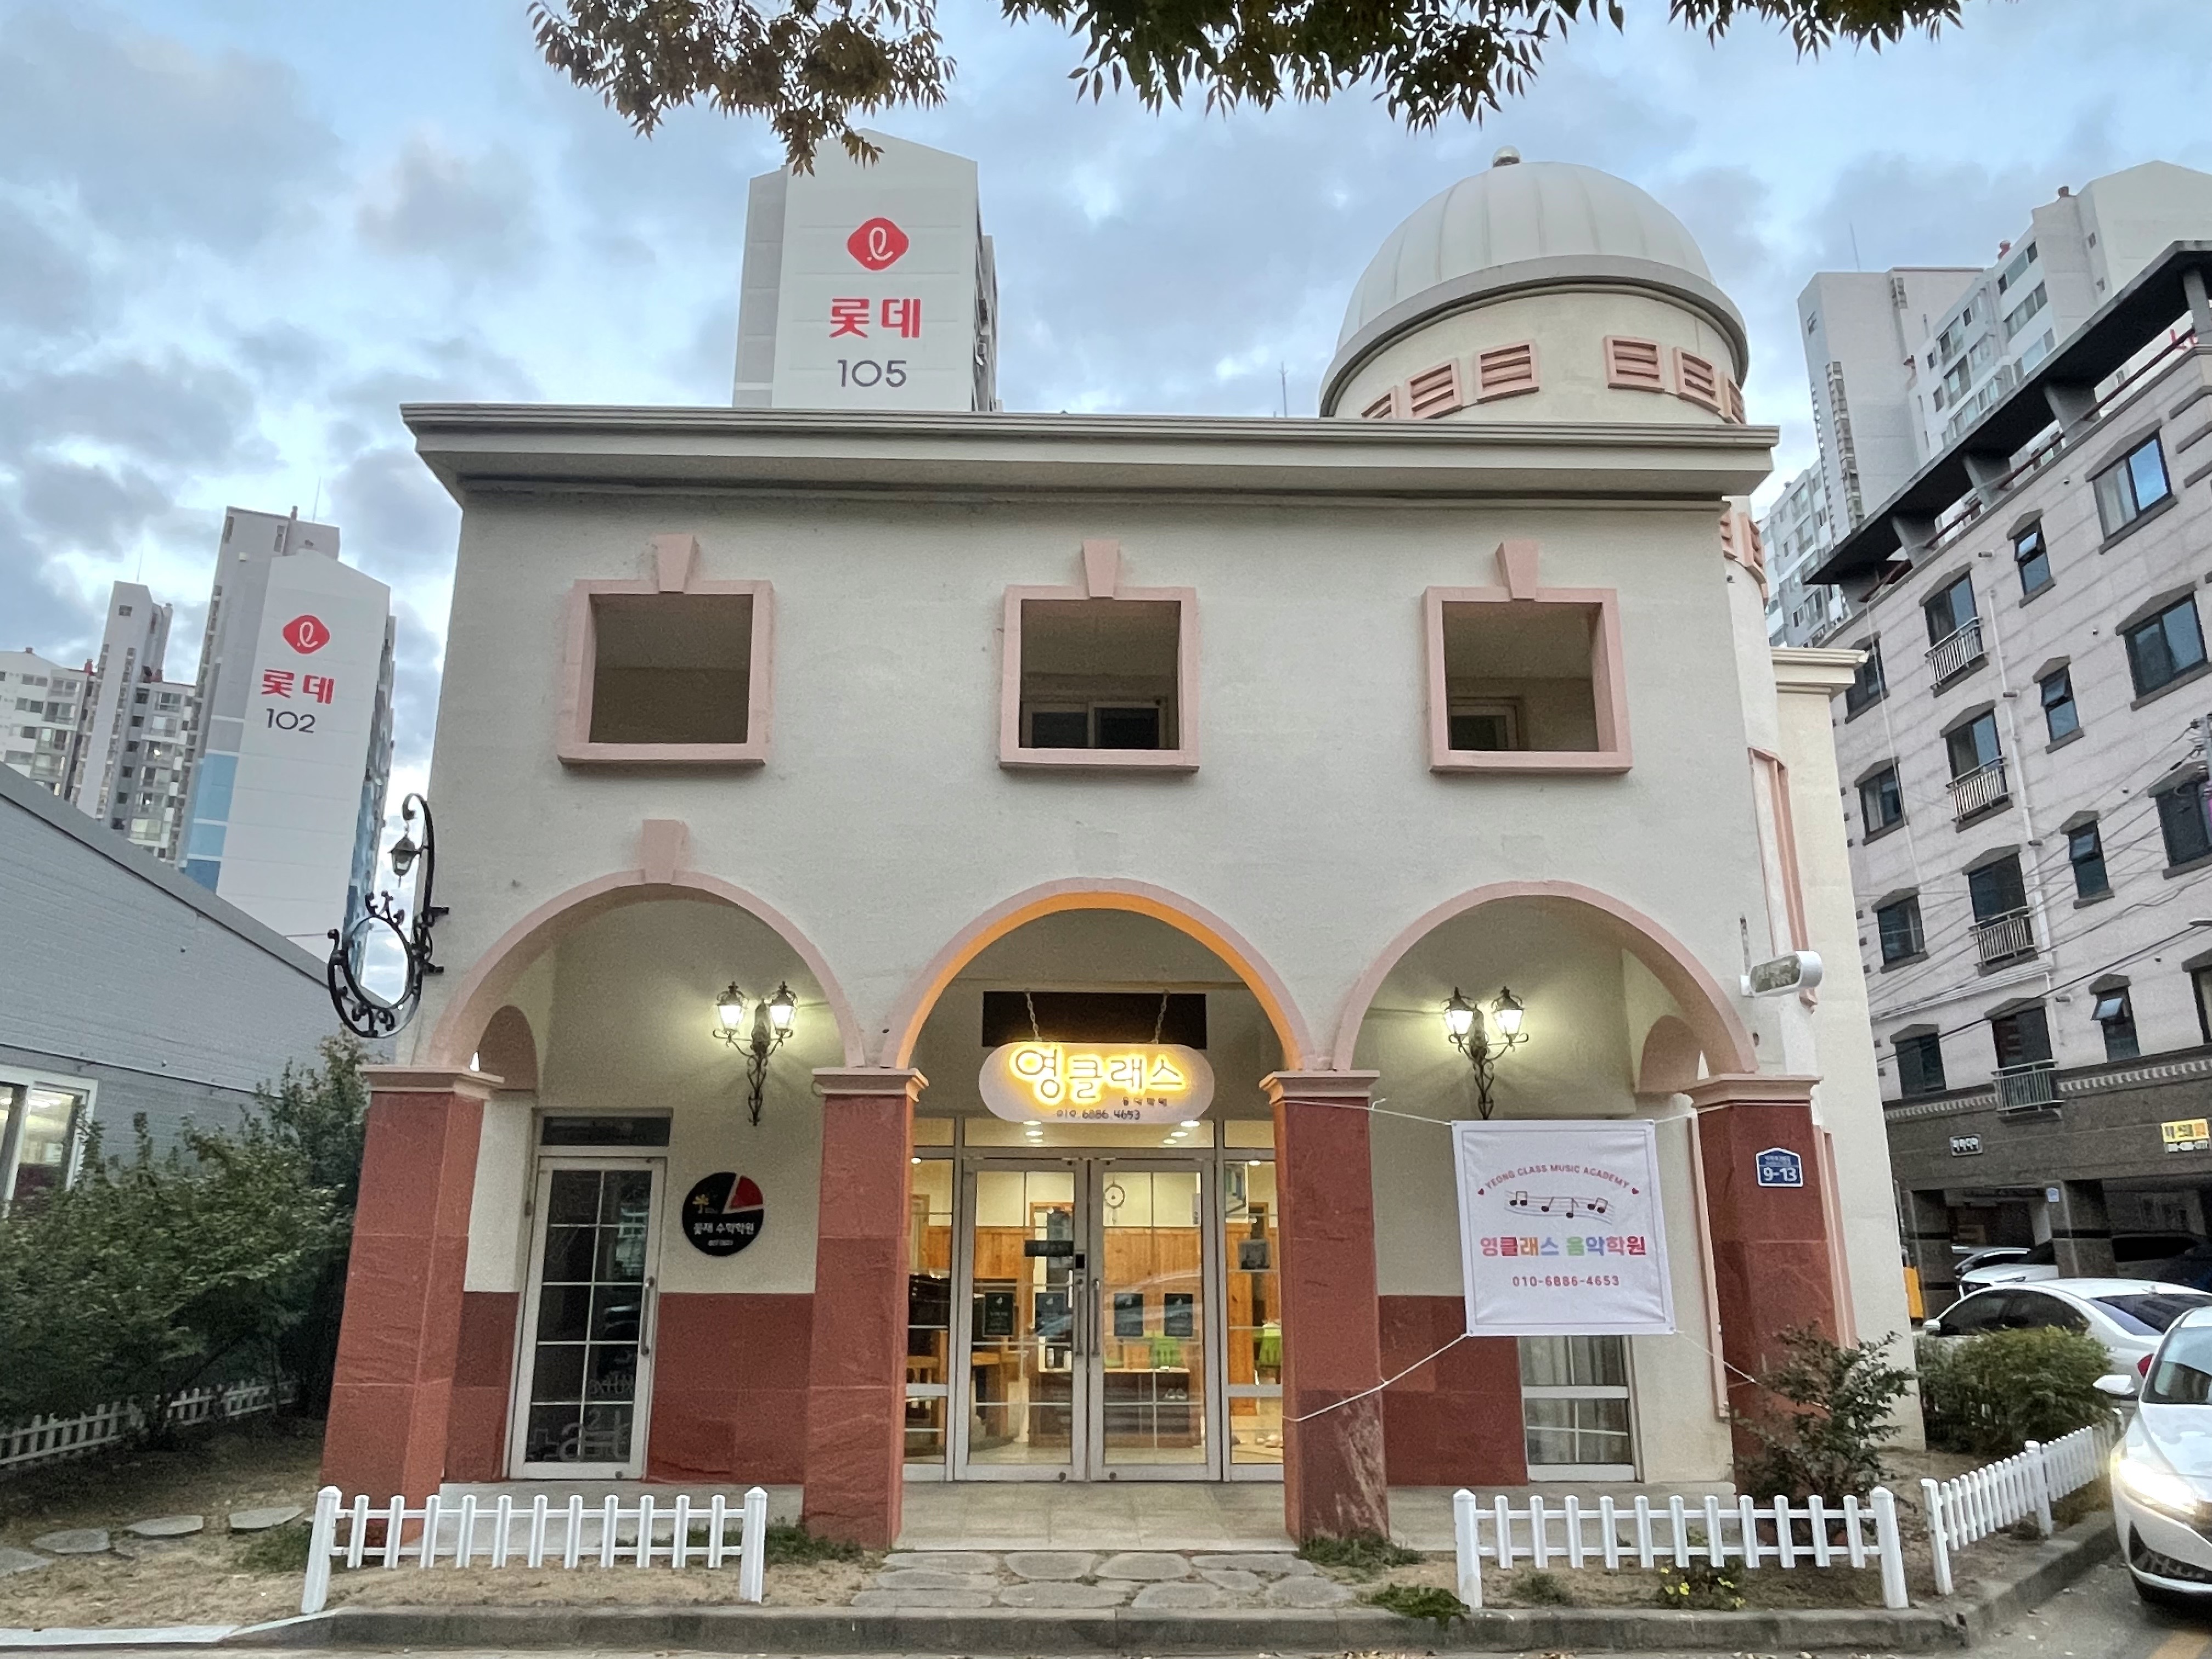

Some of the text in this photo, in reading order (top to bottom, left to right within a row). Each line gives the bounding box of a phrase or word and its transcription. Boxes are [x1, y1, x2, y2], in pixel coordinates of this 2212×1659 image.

[830, 298, 921, 338] 롯데
[837, 359, 907, 387] 105
[261, 668, 335, 704] 롯데
[266, 708, 316, 733] 102
[1013, 1047, 1184, 1101] 영클래스
[1485, 1164, 1630, 1190] YEONG CLASS MUSIC ACADEMY
[1763, 1167, 1797, 1182] 9-13
[1480, 1235, 1646, 1256] 영클래스 음악학원
[1512, 1275, 1620, 1287] 010-6886-4653
